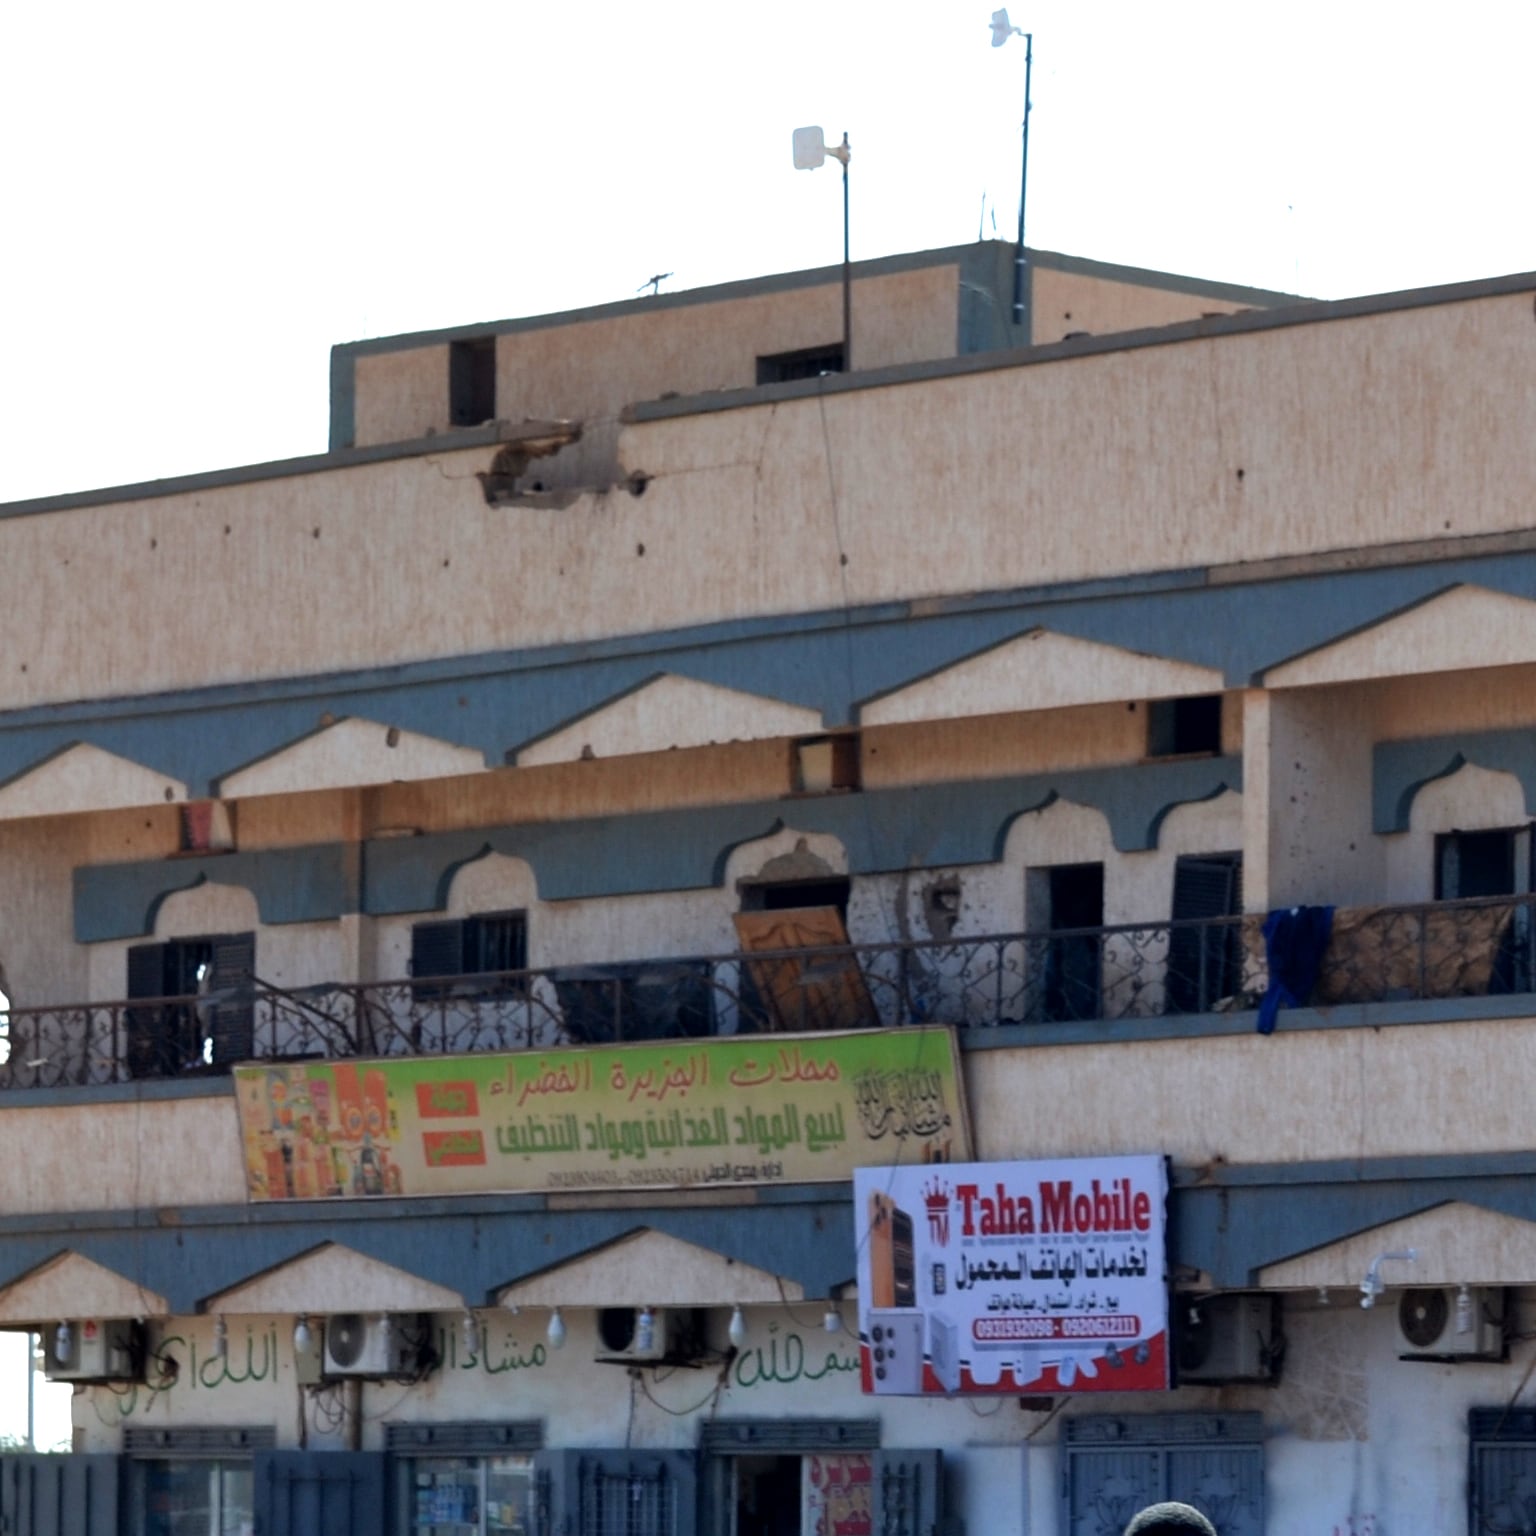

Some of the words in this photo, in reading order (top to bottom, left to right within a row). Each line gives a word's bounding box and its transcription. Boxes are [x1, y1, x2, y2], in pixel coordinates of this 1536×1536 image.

[489, 1058, 591, 1107] الخضراء
[611, 1052, 708, 1101] الجزيرة
[729, 1049, 839, 1087] محلات
[496, 1114, 581, 1162] التنظيف
[734, 1103, 800, 1155] المواد
[805, 1102, 846, 1153] لبيع
[956, 1183, 1034, 1236] Taha
[1039, 1178, 1151, 1234] Mobile
[956, 1250, 1029, 1291] المحمول
[1030, 1249, 1084, 1287] الهاتف
[1086, 1247, 1148, 1278] لخدمات
